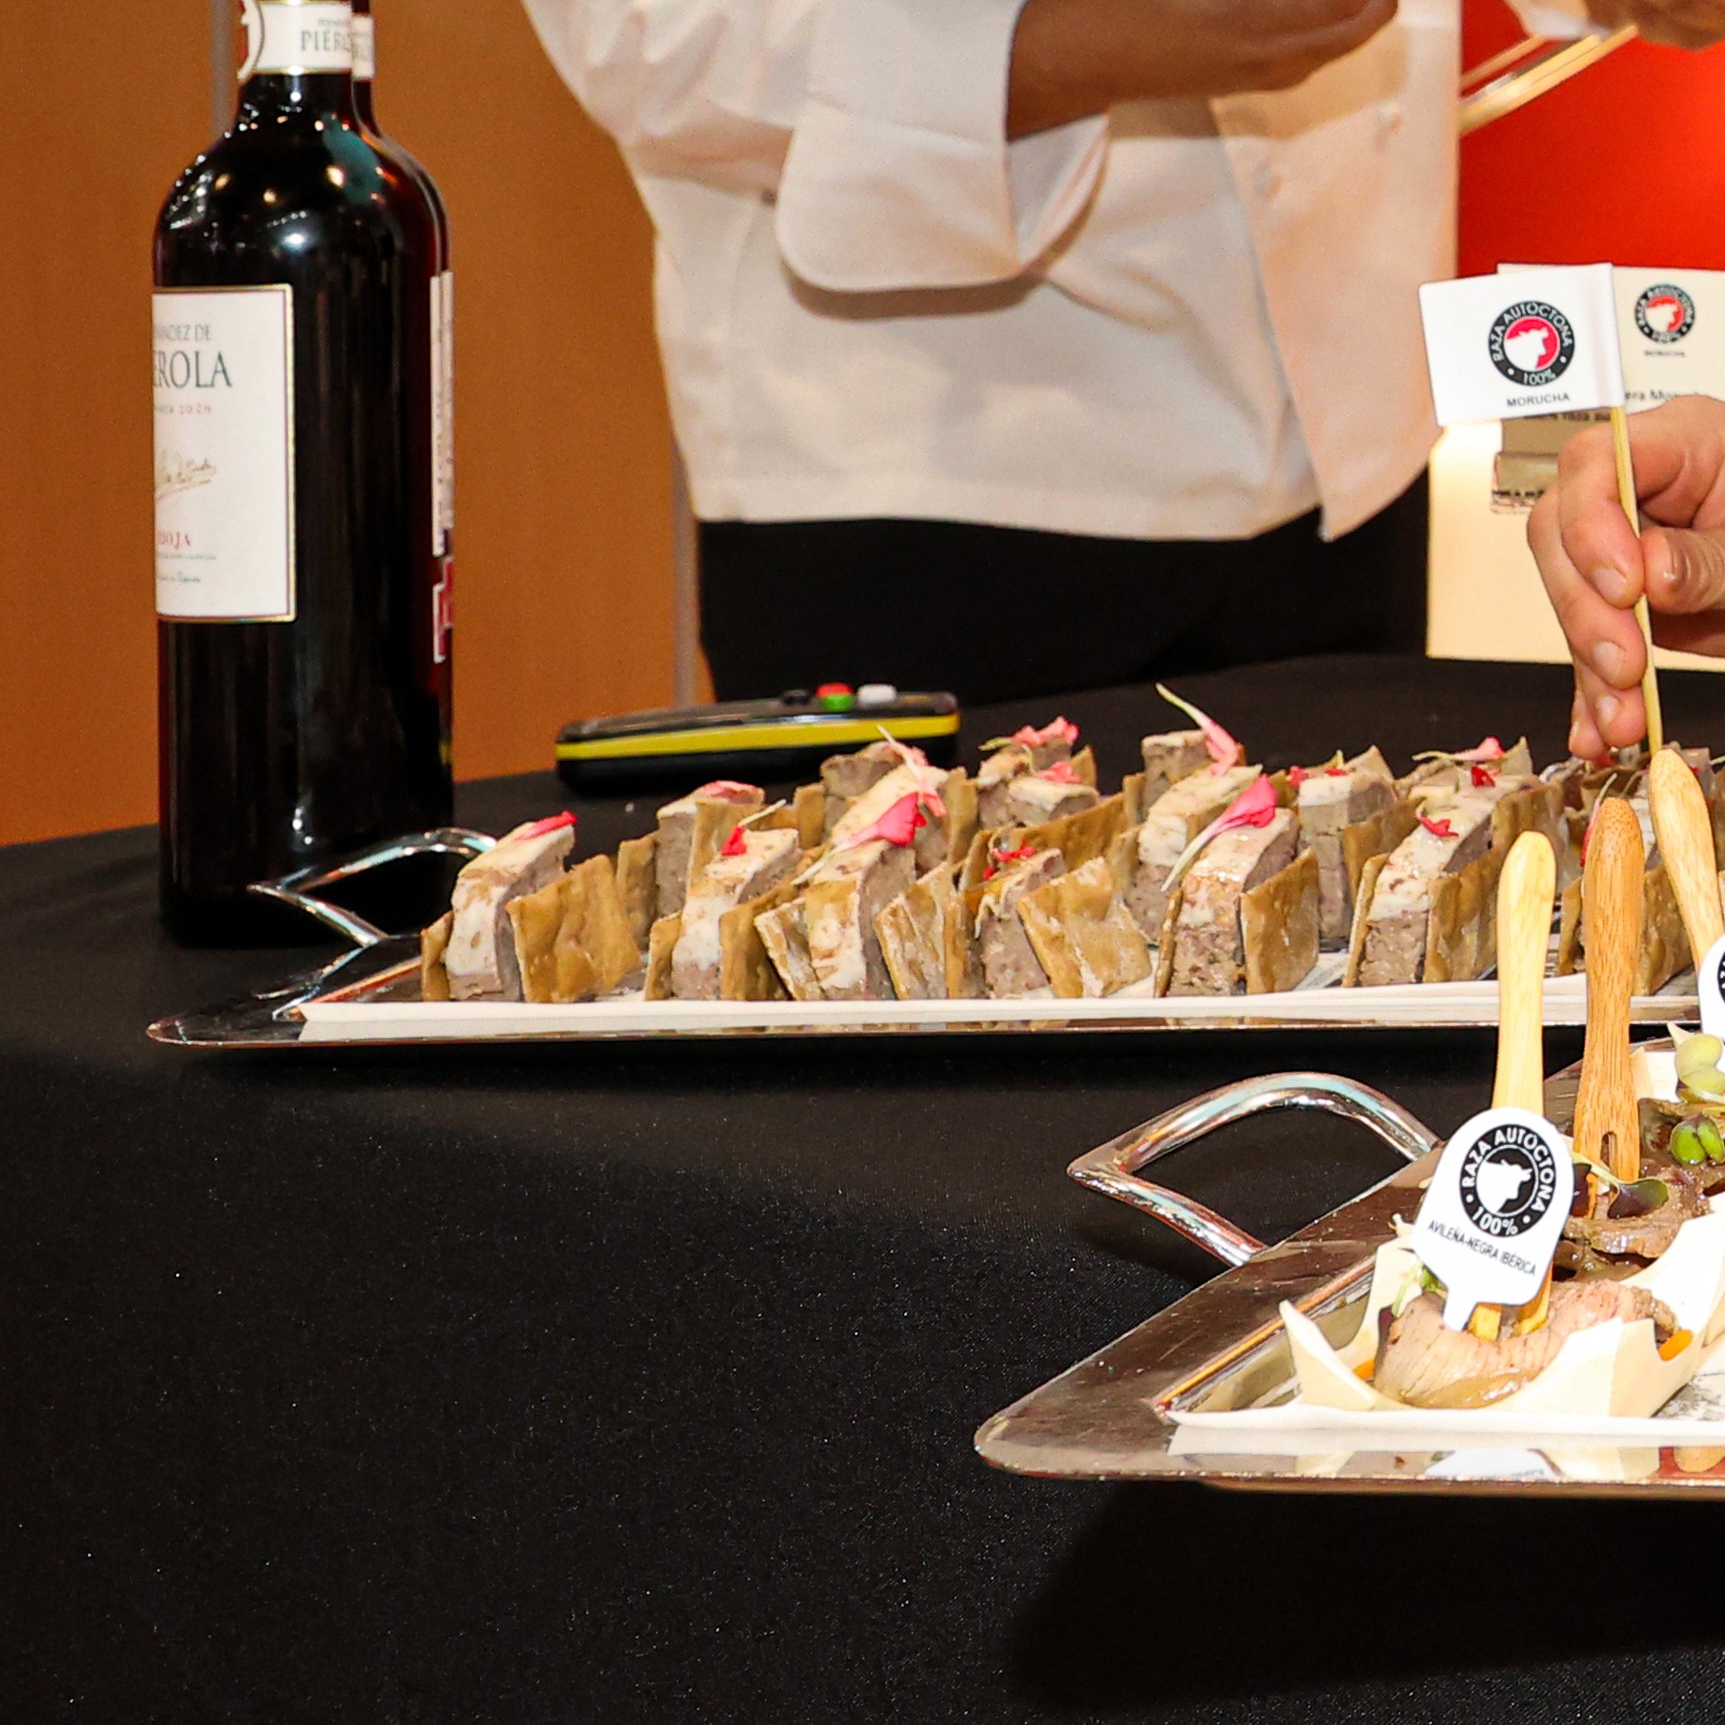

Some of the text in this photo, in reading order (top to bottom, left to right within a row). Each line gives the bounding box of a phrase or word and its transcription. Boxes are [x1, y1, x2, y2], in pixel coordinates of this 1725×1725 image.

[1506, 392, 1570, 407] MORUCHA
[1462, 1141, 1491, 1189] RAZA
[1472, 1206, 1519, 1236] 100%
[1427, 1219, 1536, 1276] AVILEÑA-NEGRA IBÉRICA
